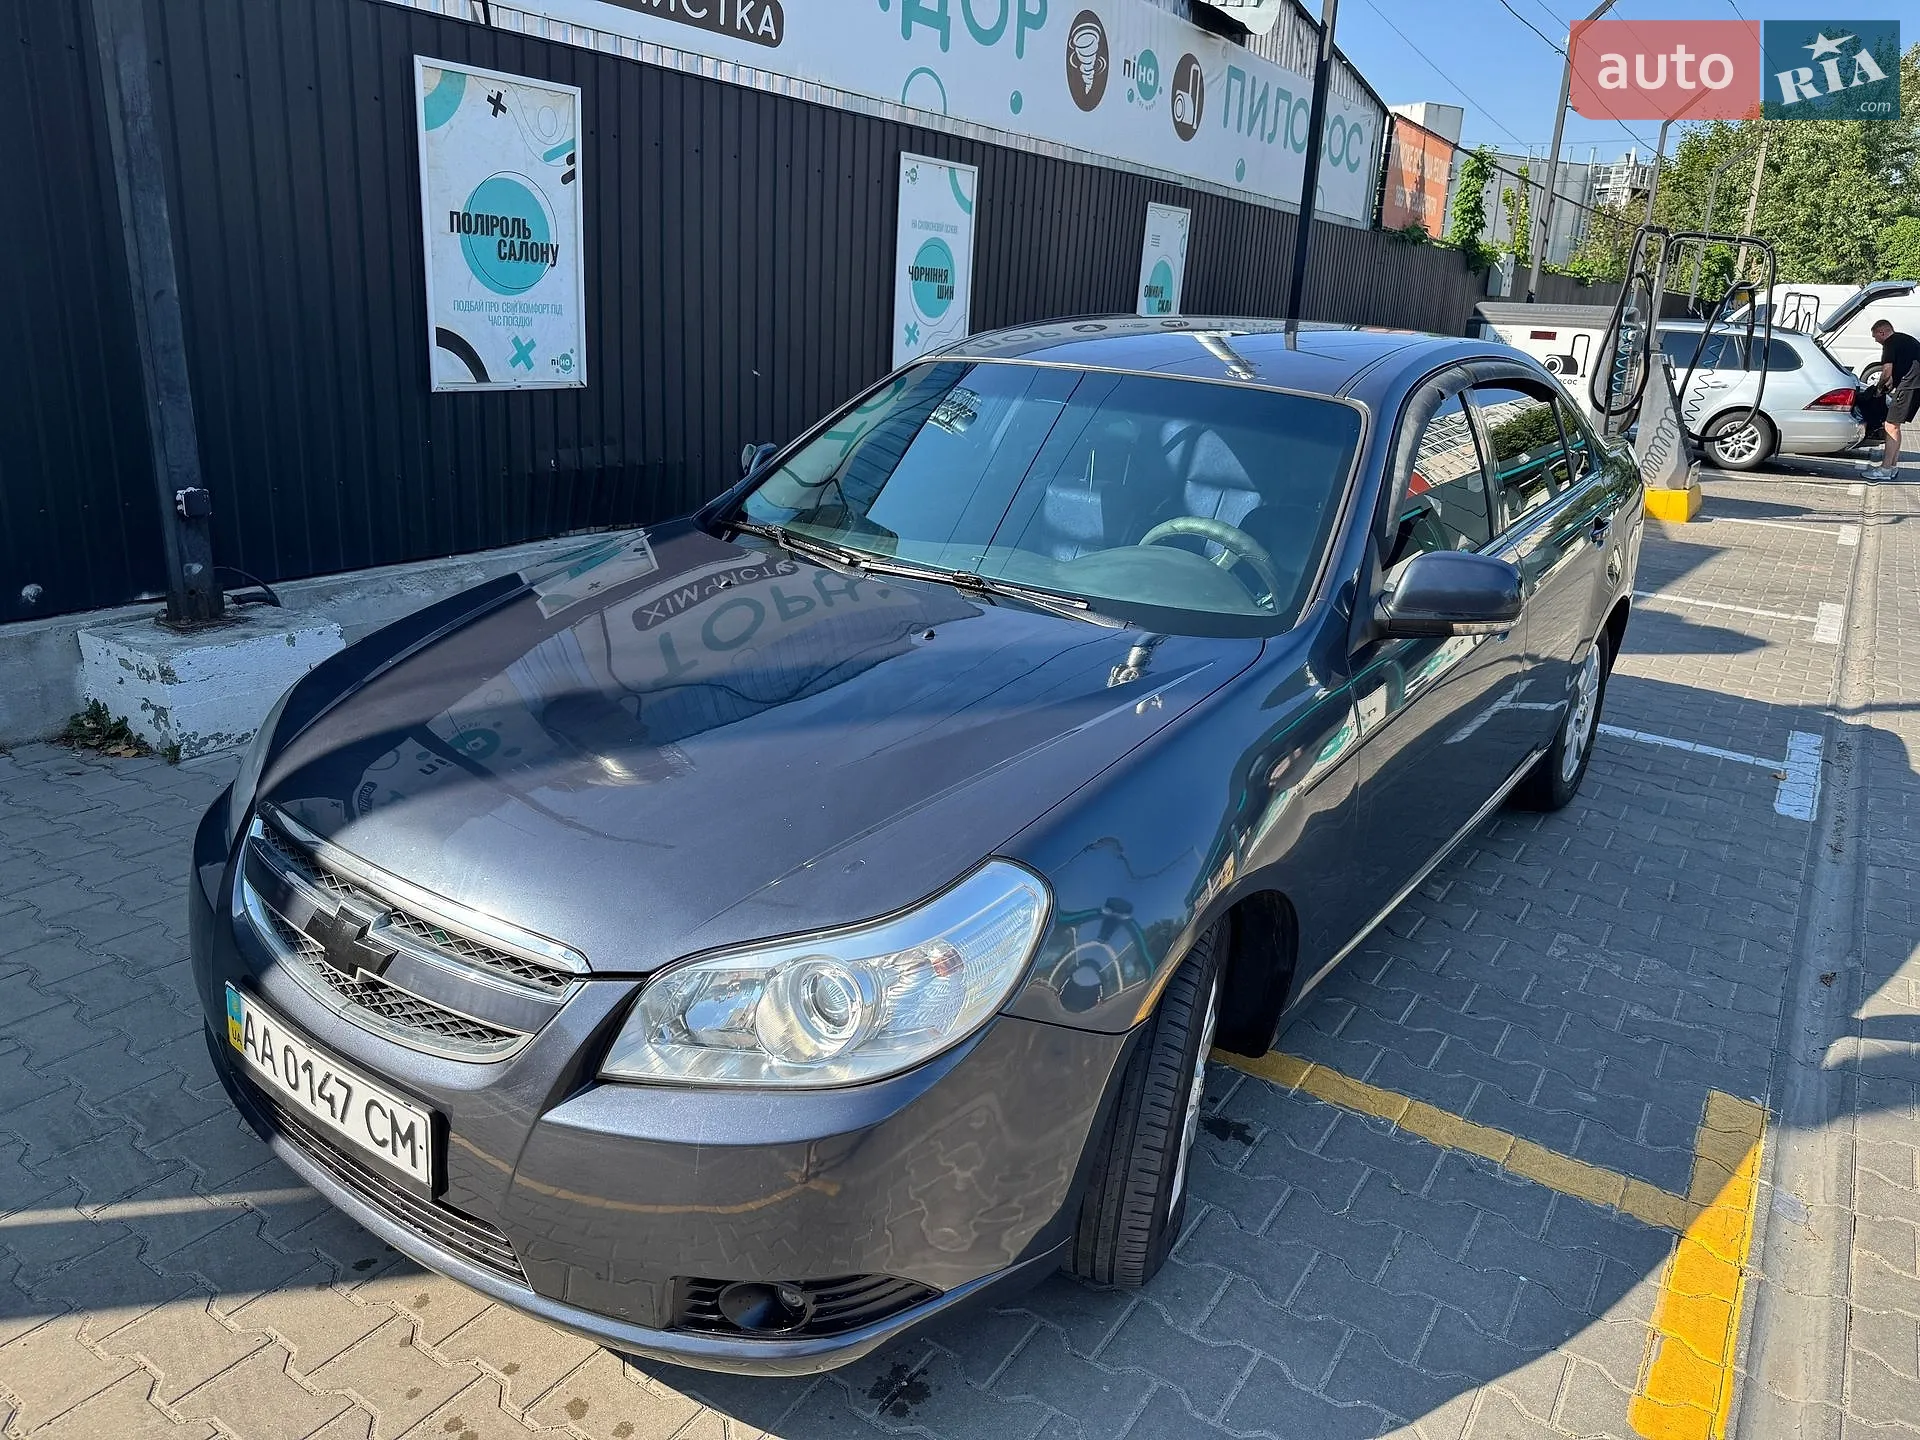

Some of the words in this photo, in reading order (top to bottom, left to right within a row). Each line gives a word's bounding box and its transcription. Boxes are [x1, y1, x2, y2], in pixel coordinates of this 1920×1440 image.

[1123, 55, 1155, 87] піна
[1223, 64, 1364, 174] ПИЛООС
[449, 210, 532, 240] ПОЛІРОЛЬ
[497, 238, 560, 268] САЛОНУ
[908, 265, 949, 284] ЧОРНІННЯ
[936, 284, 955, 301] ШИН
[453, 299, 484, 312] ПОДБАЙ
[485, 302, 499, 313] ПРО
[519, 302, 550, 315] КОМФОРТ
[550, 303, 563, 316] ПІД
[488, 315, 502, 327] ЧАС
[503, 315, 533, 328] ПОЇЗДКИ
[551, 356, 570, 367] піна
[231, 1027, 243, 1044] UA
[243, 1010, 279, 1078] AA
[283, 1043, 353, 1125] 0147
[364, 1098, 418, 1170] CM
